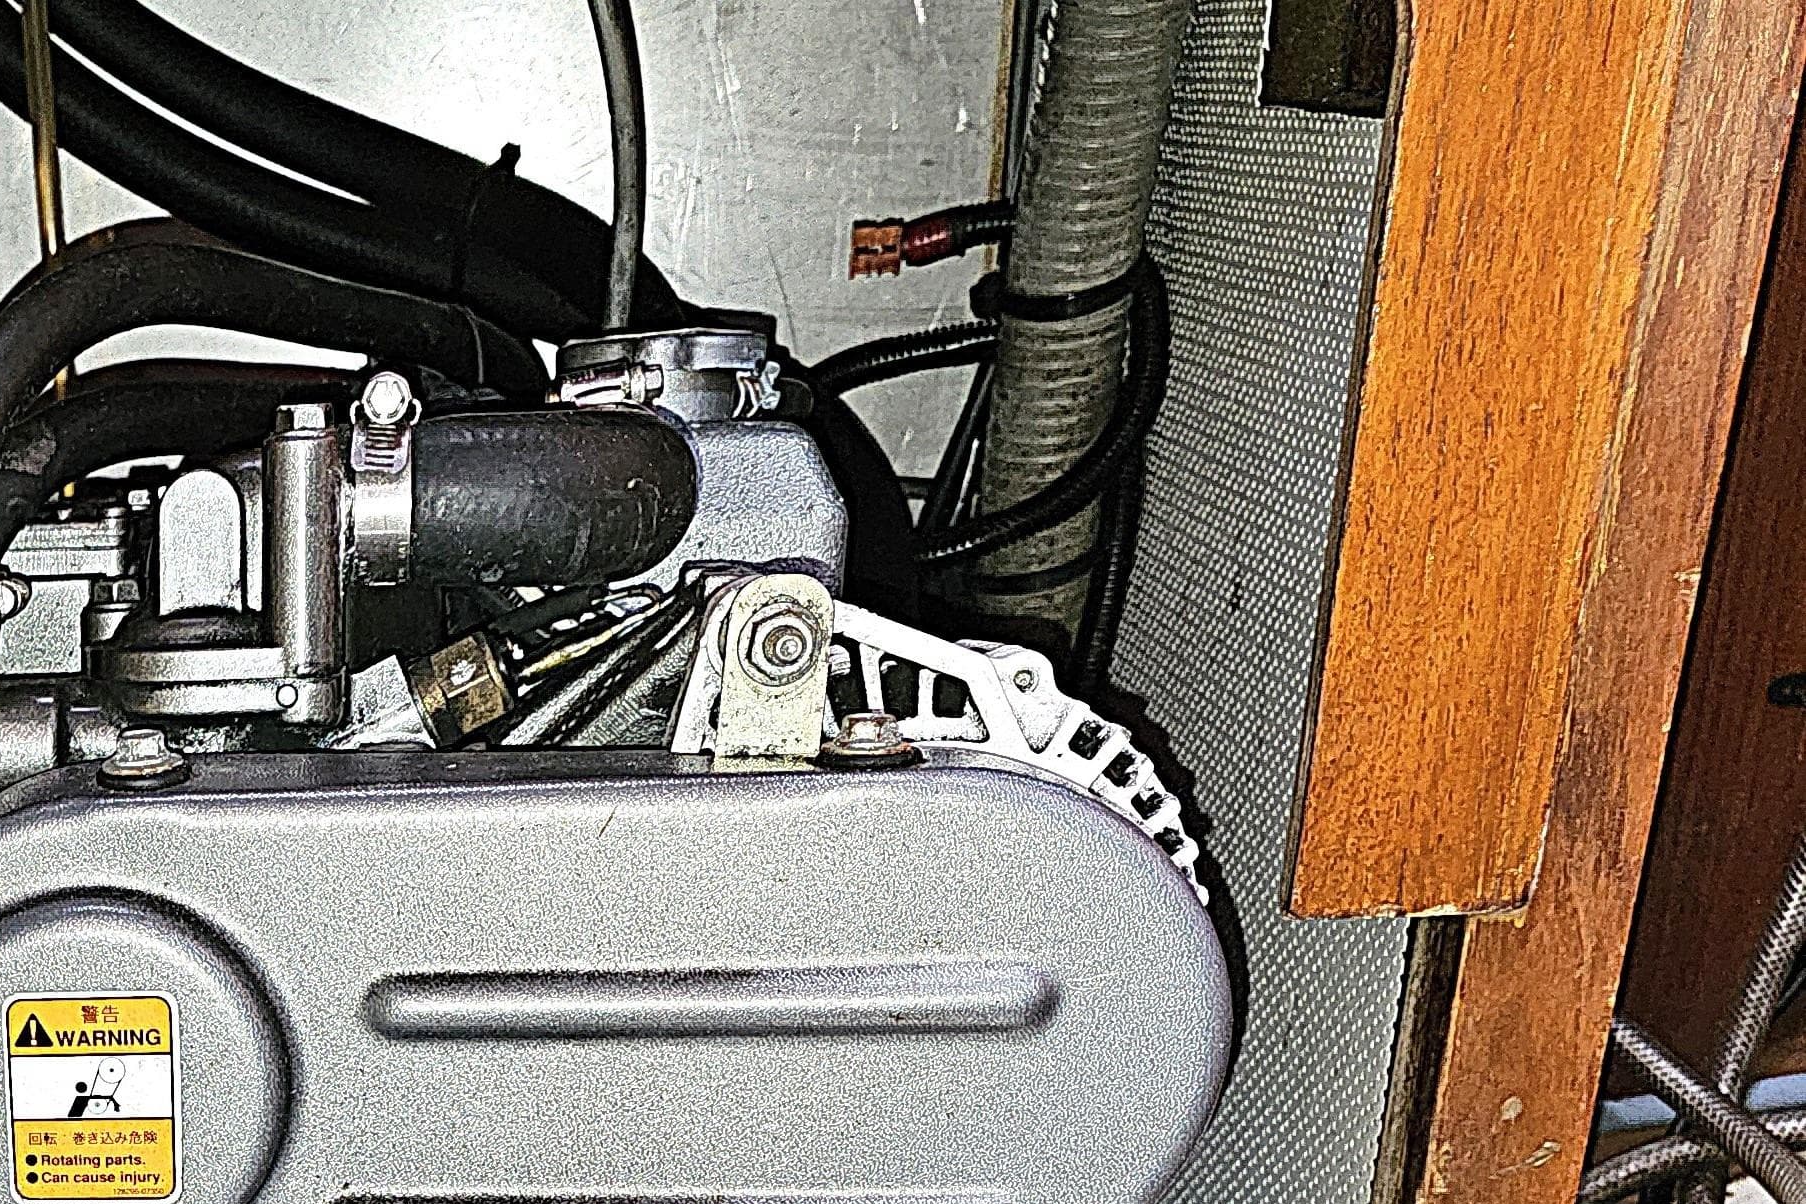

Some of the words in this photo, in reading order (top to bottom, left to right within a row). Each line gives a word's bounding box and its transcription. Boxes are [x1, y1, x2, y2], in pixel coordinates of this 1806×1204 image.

[81, 1005, 119, 1024] 警告
[55, 1028, 161, 1047] WARNING
[41, 1154, 101, 1169] Rotating
[105, 1154, 146, 1168] parts.
[41, 1171, 69, 1184] Can
[73, 1172, 116, 1184] cause
[120, 1170, 165, 1186] injury.
